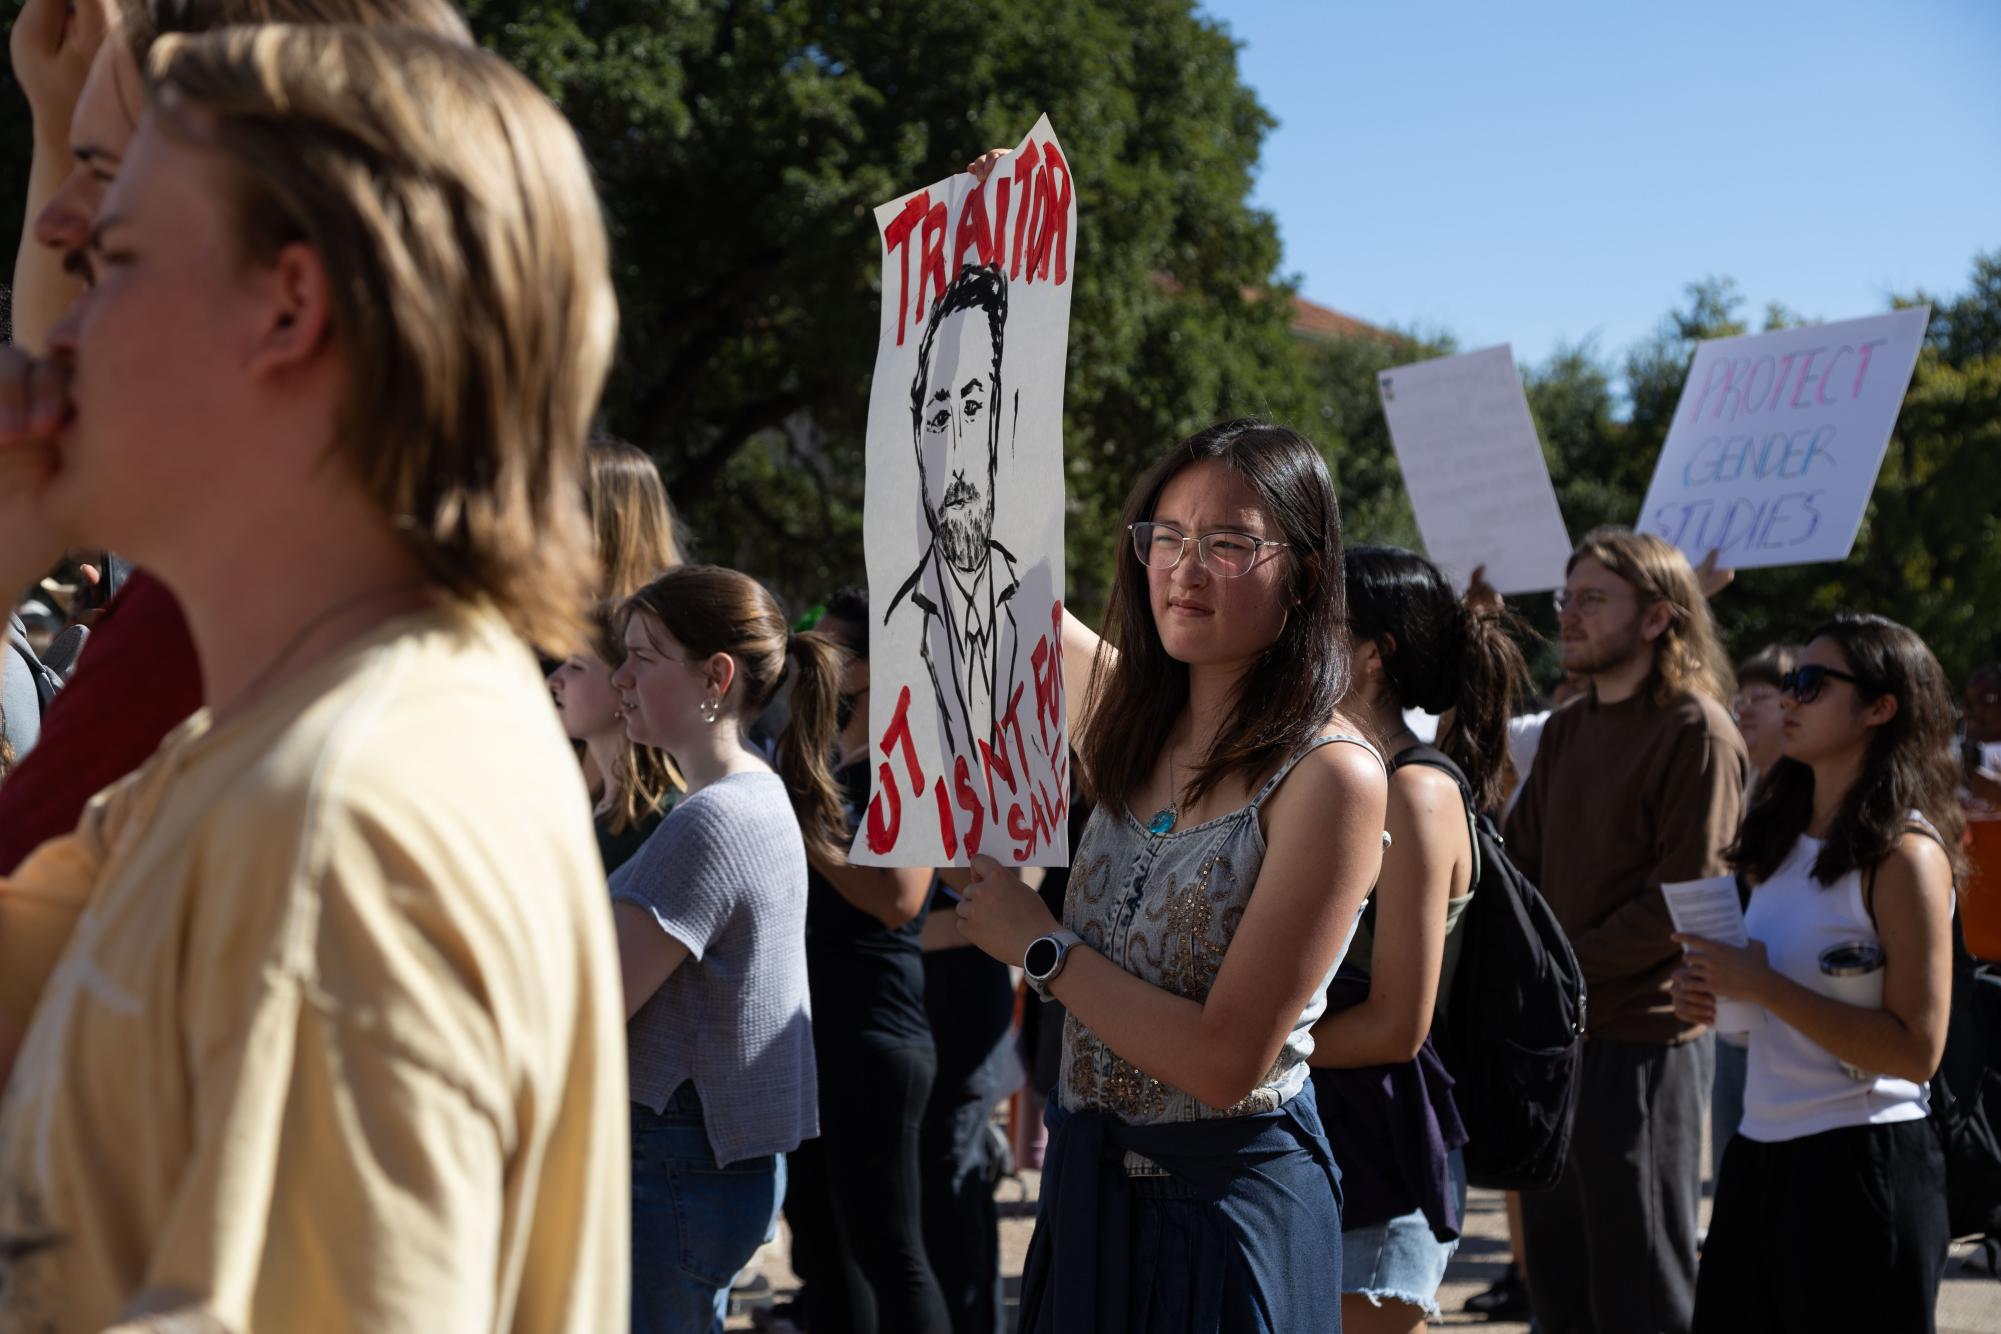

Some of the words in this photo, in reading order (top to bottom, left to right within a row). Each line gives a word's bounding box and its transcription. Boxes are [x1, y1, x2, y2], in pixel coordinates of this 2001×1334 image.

[885, 137, 1071, 347] TRAITOR
[1688, 339, 1888, 425] PROTECT
[1683, 424, 1837, 488] GENDER
[1655, 489, 1826, 551] STUDIES
[867, 685, 925, 854] UT
[1031, 600, 1063, 757] FOR
[1007, 731, 1069, 862] SALE
